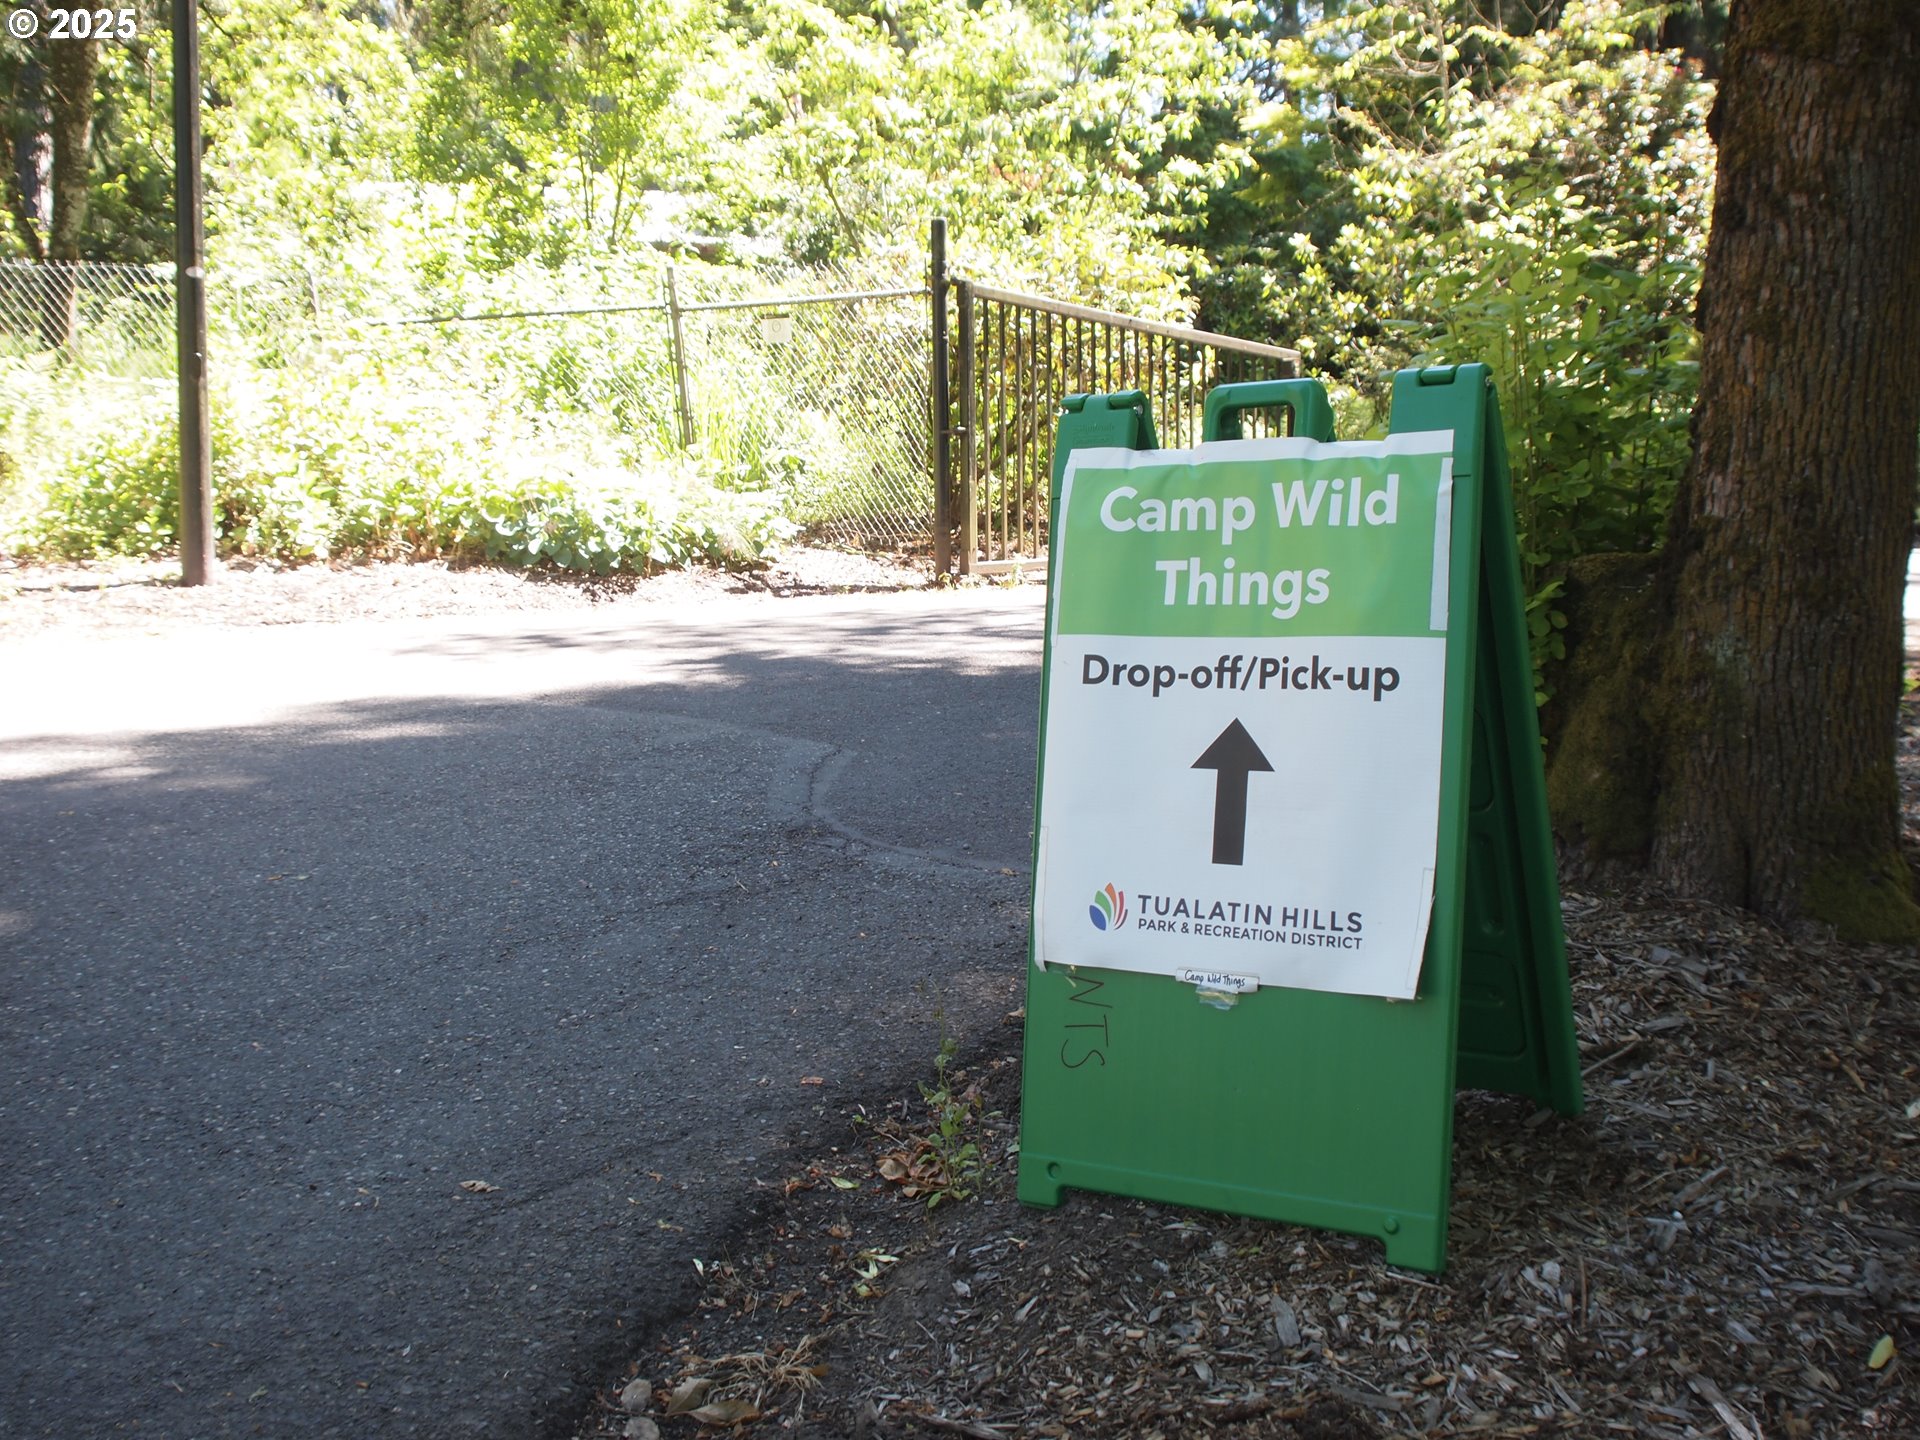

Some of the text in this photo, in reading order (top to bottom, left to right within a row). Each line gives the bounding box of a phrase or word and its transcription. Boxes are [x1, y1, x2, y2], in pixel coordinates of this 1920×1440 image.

[1100, 473, 1400, 545] Camp Wild
[1155, 556, 1331, 620] Things
[1082, 653, 1401, 702] Drop-off/Pick-up
[1138, 894, 1363, 933] TUALATIN HILLS
[1138, 918, 1363, 950] PARK & RECREATION DISTRICT
[1184, 969, 1245, 990] Camp Wild Things
